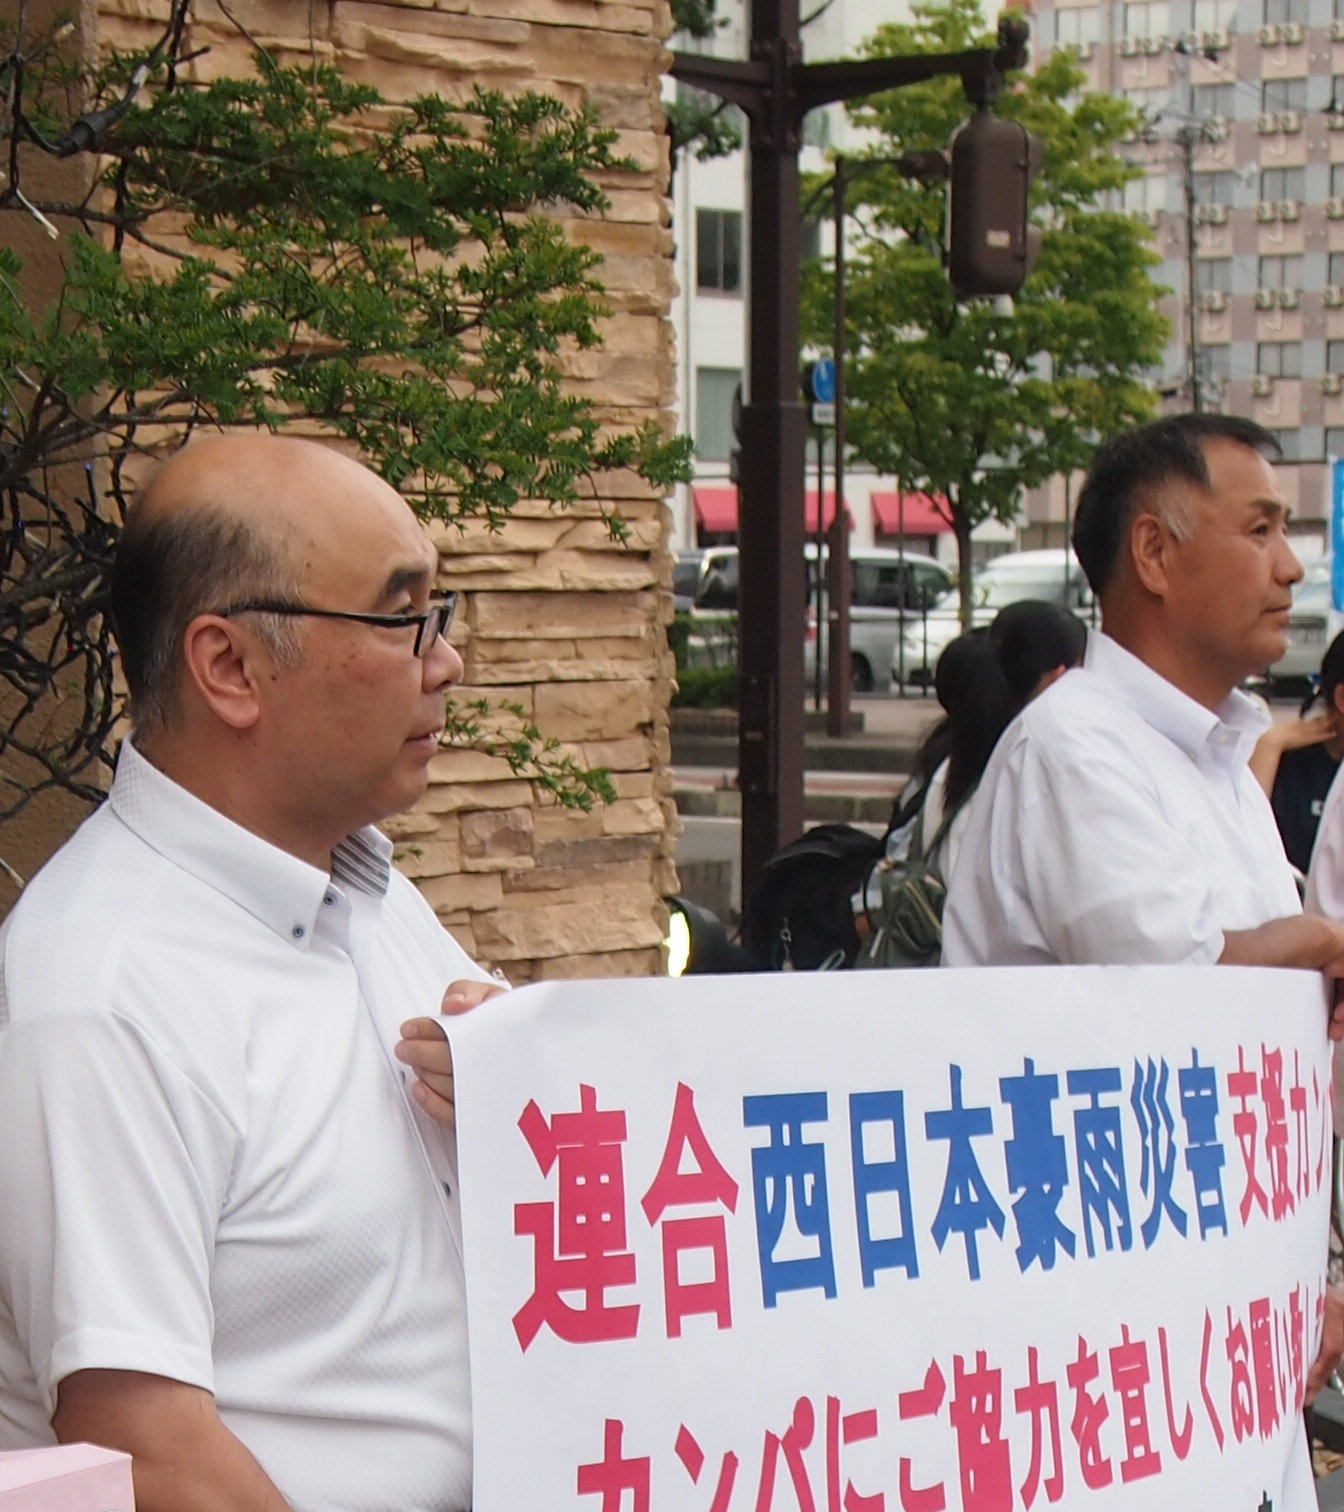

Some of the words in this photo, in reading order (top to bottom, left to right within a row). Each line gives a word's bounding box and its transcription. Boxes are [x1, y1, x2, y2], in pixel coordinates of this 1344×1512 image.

[511, 1041, 1334, 1354] 連合西日本豪雨災害支援カン
